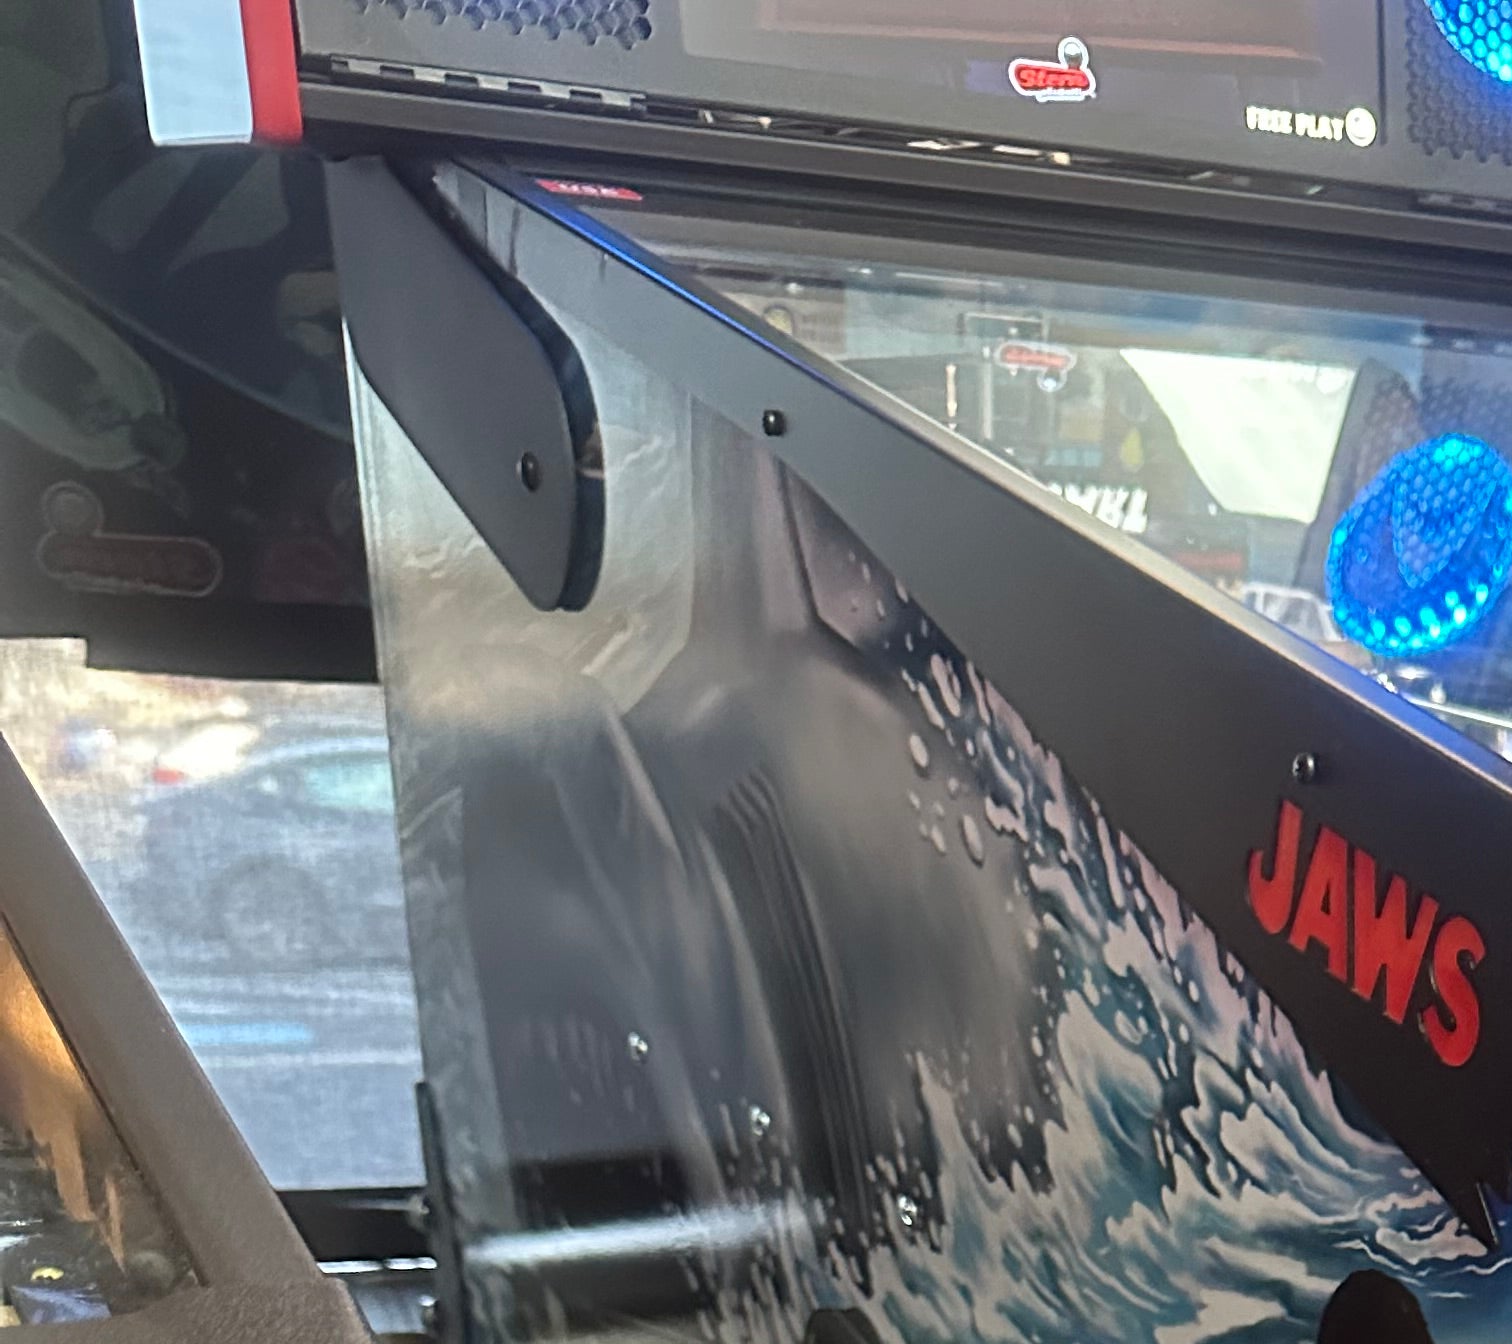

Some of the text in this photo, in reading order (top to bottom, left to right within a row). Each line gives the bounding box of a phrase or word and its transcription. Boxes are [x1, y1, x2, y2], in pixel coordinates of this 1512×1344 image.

[1019, 68, 1089, 88] Stern
[1246, 105, 1344, 141] FREE PLAY
[1248, 799, 1486, 1067] JAWS
